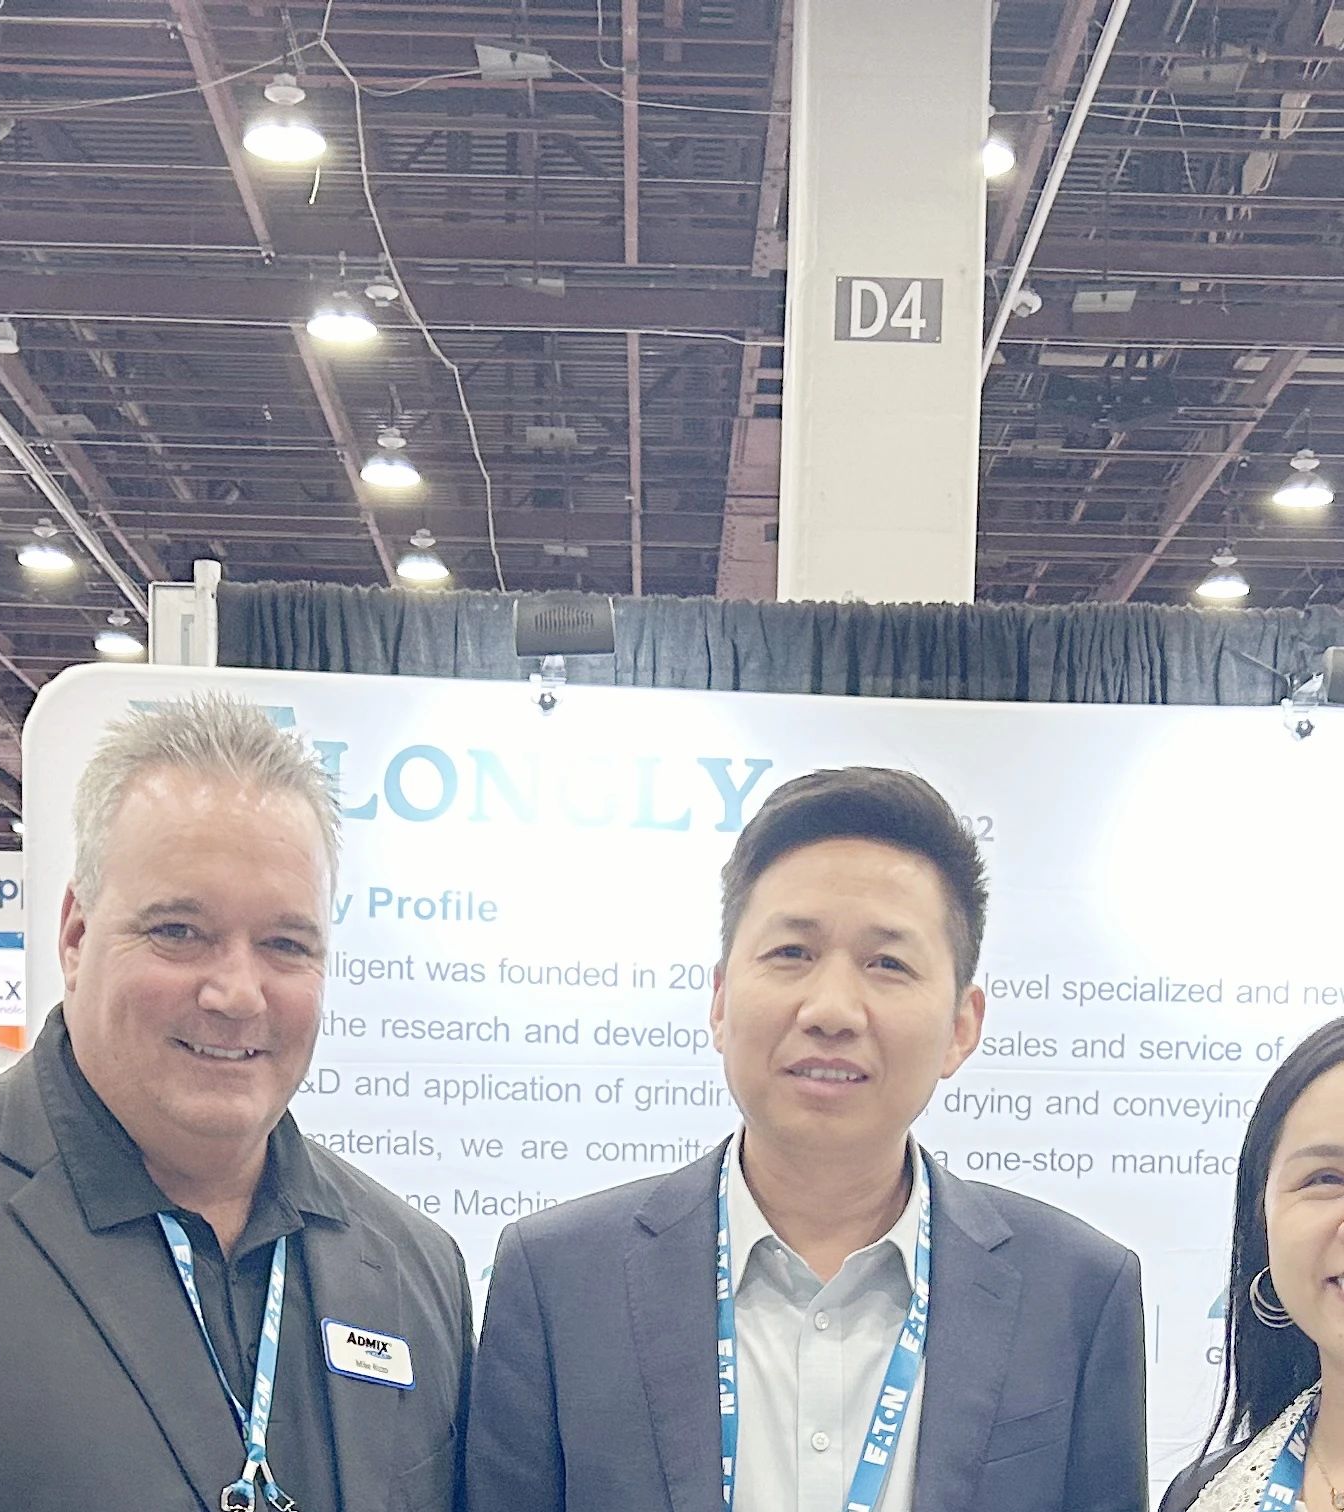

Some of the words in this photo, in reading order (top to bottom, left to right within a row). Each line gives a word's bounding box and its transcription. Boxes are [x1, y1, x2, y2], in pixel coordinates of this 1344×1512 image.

[850, 279, 926, 339] D4
[369, 886, 498, 922] Profile
[425, 961, 486, 983] was
[500, 957, 619, 988] founded
[632, 962, 656, 989] in
[985, 972, 1050, 1000] level
[1062, 975, 1223, 1007] specialized
[1236, 980, 1289, 1005] and
[321, 1012, 367, 1038] the
[381, 1015, 510, 1043] research
[524, 1018, 579, 1045] and
[593, 1021, 710, 1055] develop
[982, 1031, 1058, 1058] sales
[1071, 1033, 1126, 1060] and
[1139, 1035, 1243, 1062] service
[1255, 1036, 1285, 1062] of
[355, 1070, 410, 1098] and
[424, 1073, 582, 1106] application
[595, 1077, 624, 1104] of
[944, 1088, 1033, 1121] drying
[1045, 1090, 1100, 1116] and
[460, 1136, 504, 1159] we
[521, 1139, 570, 1160] are
[966, 1148, 1094, 1179] one-stop
[899, 1275, 930, 1355] EATON
[346, 1331, 388, 1356] ADMIX
[862, 1385, 909, 1467] EATON
